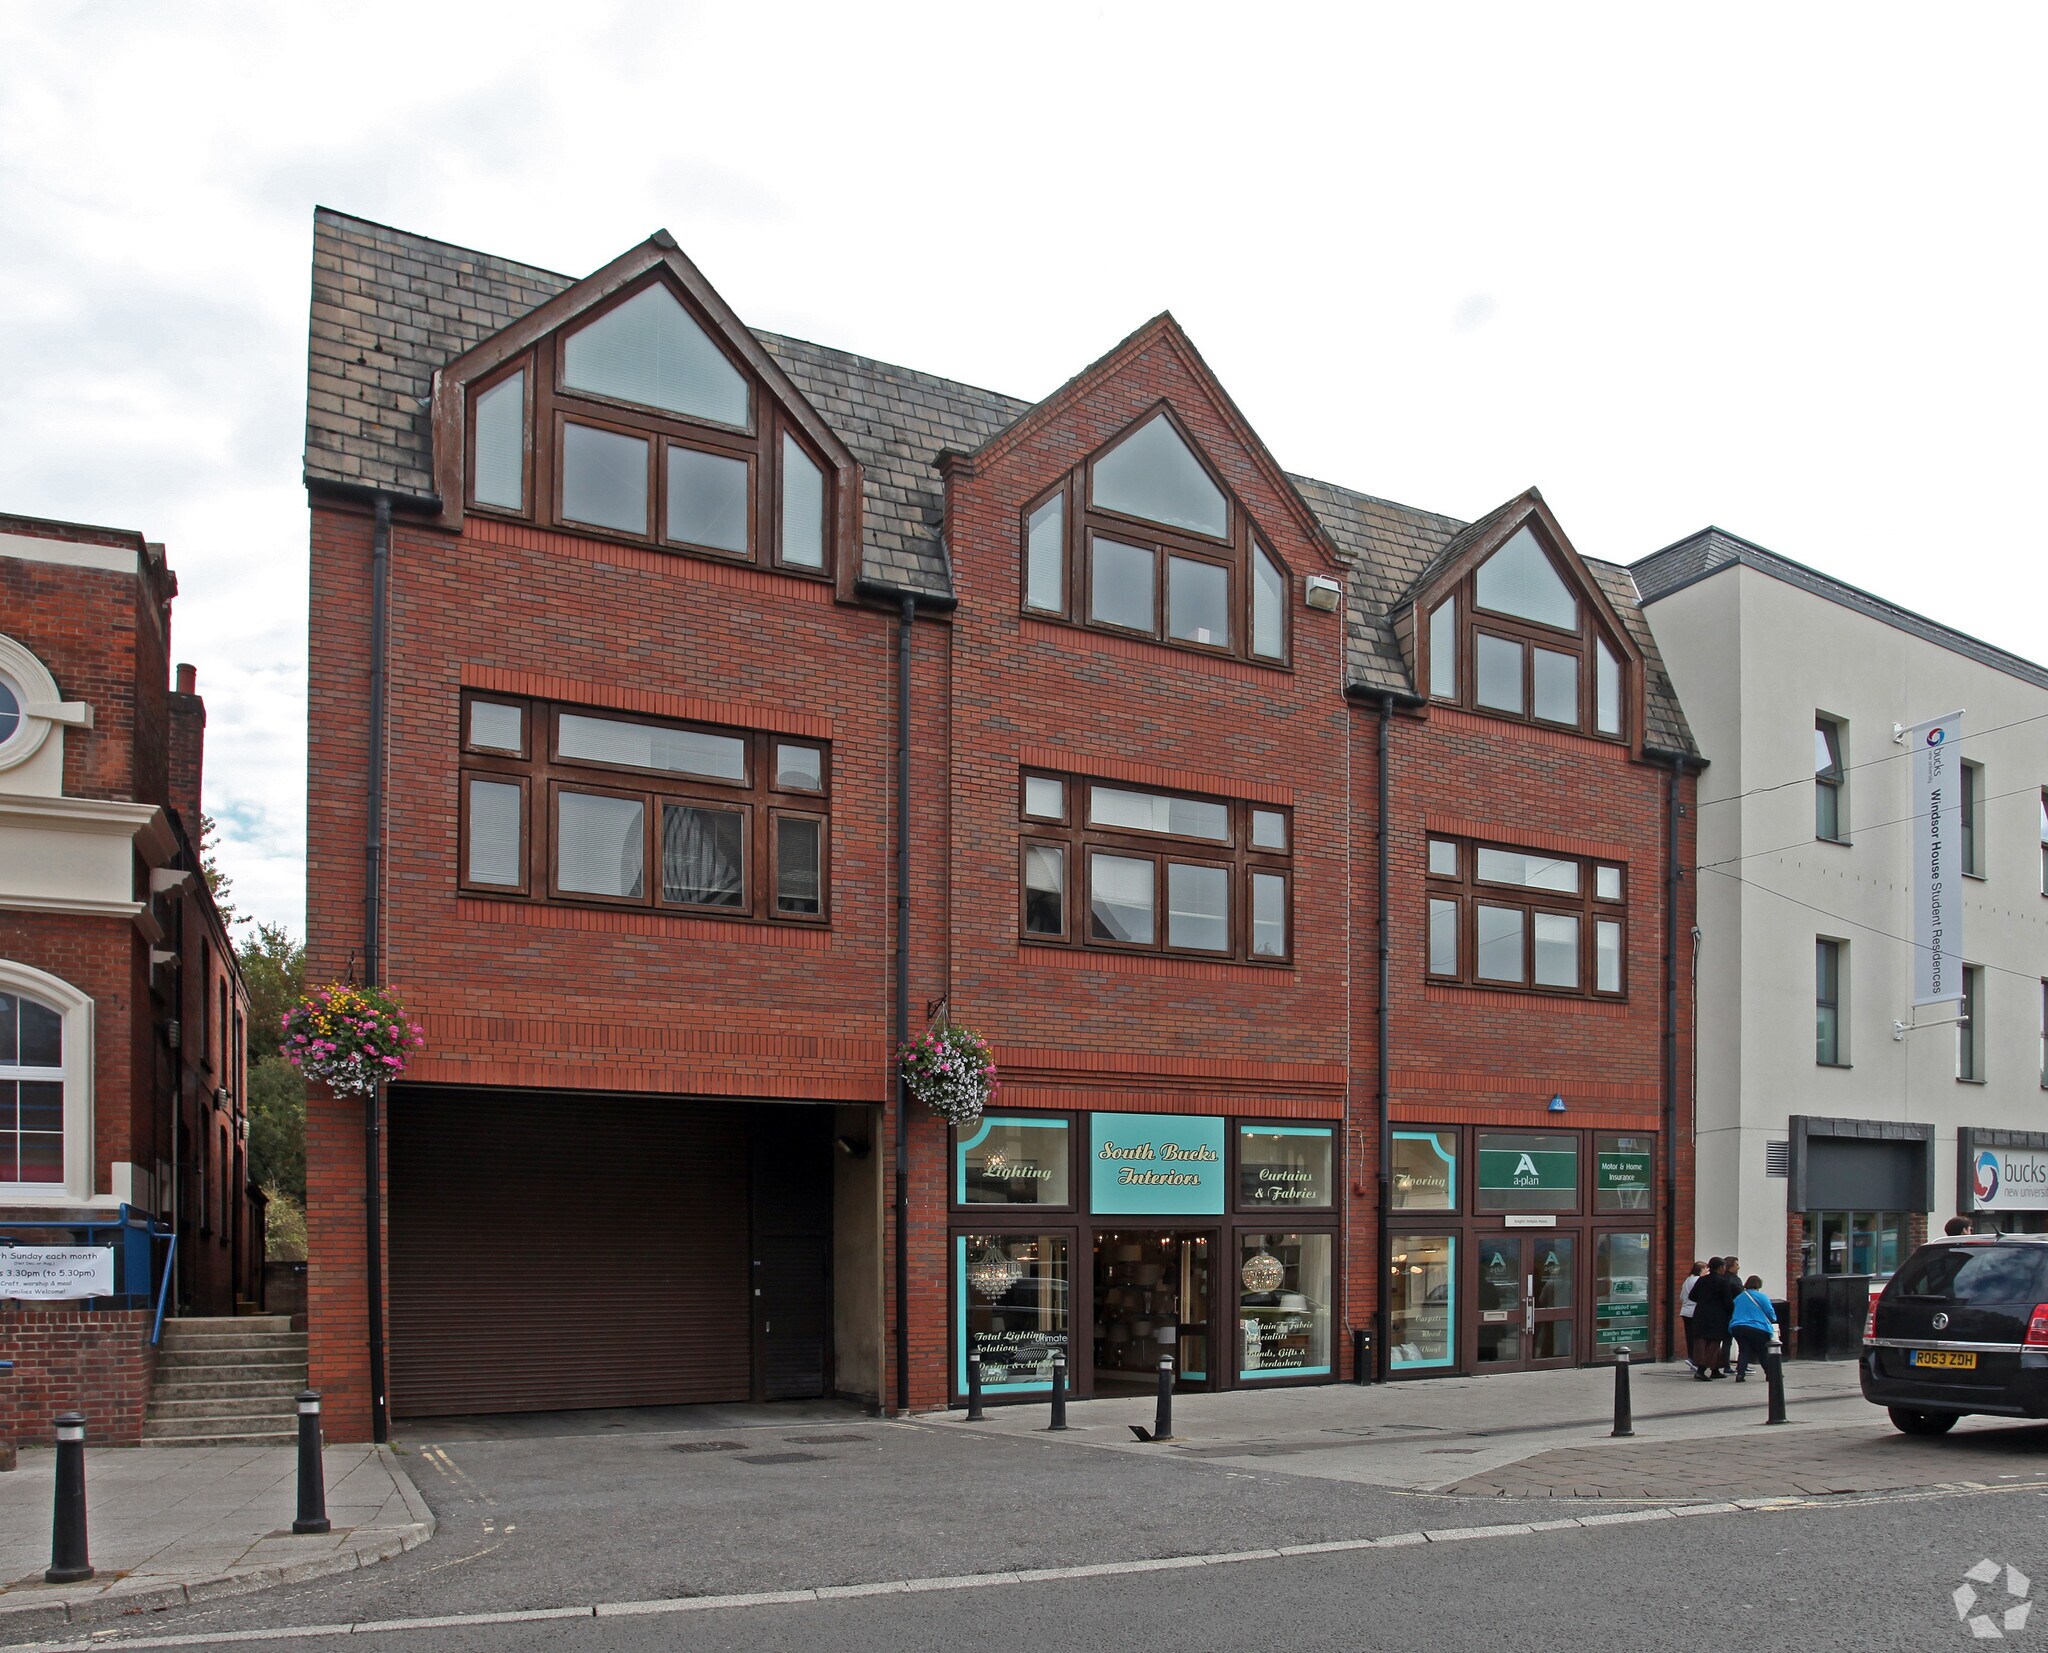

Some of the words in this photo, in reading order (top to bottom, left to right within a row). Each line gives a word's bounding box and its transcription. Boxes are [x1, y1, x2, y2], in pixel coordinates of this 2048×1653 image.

[1934, 747, 1944, 777] bucks
[1931, 788, 1942, 838] Windsor
[1931, 841, 1942, 880] House
[1932, 882, 1942, 926] Student
[1932, 930, 1942, 994] Residences
[1098, 1141, 1156, 1160] South
[1160, 1142, 1218, 1162] Bucks
[982, 1163, 1052, 1181] Lighting
[1260, 1168, 1312, 1181] Curtains
[2004, 1154, 2046, 1183] bucks
[1118, 1166, 1201, 1186] Interiors
[1393, 1173, 1446, 1188] Flooring
[1513, 1176, 1539, 1187] a-plan
[1255, 1188, 1264, 1198] &
[1268, 1186, 1317, 1200] Fabrics
[2004, 1188, 2018, 1197] new
[10, 1253, 42, 1262] Sunday
[7, 1269, 40, 1278] 3.30pm
[43, 1269, 56, 1278] (to
[59, 1269, 96, 1278] 5.30pm)
[1289, 1321, 1313, 1330] Fabric
[1415, 1315, 1441, 1323] Carpets
[974, 1332, 1002, 1341] Total
[1248, 1333, 1287, 1341] ecialists
[976, 1344, 1018, 1353] Solutions
[1278, 1348, 1297, 1358] Gifts
[1917, 1352, 1946, 1365] RO63
[1949, 1354, 1973, 1366] ZDH
[979, 1362, 1009, 1370] Design
